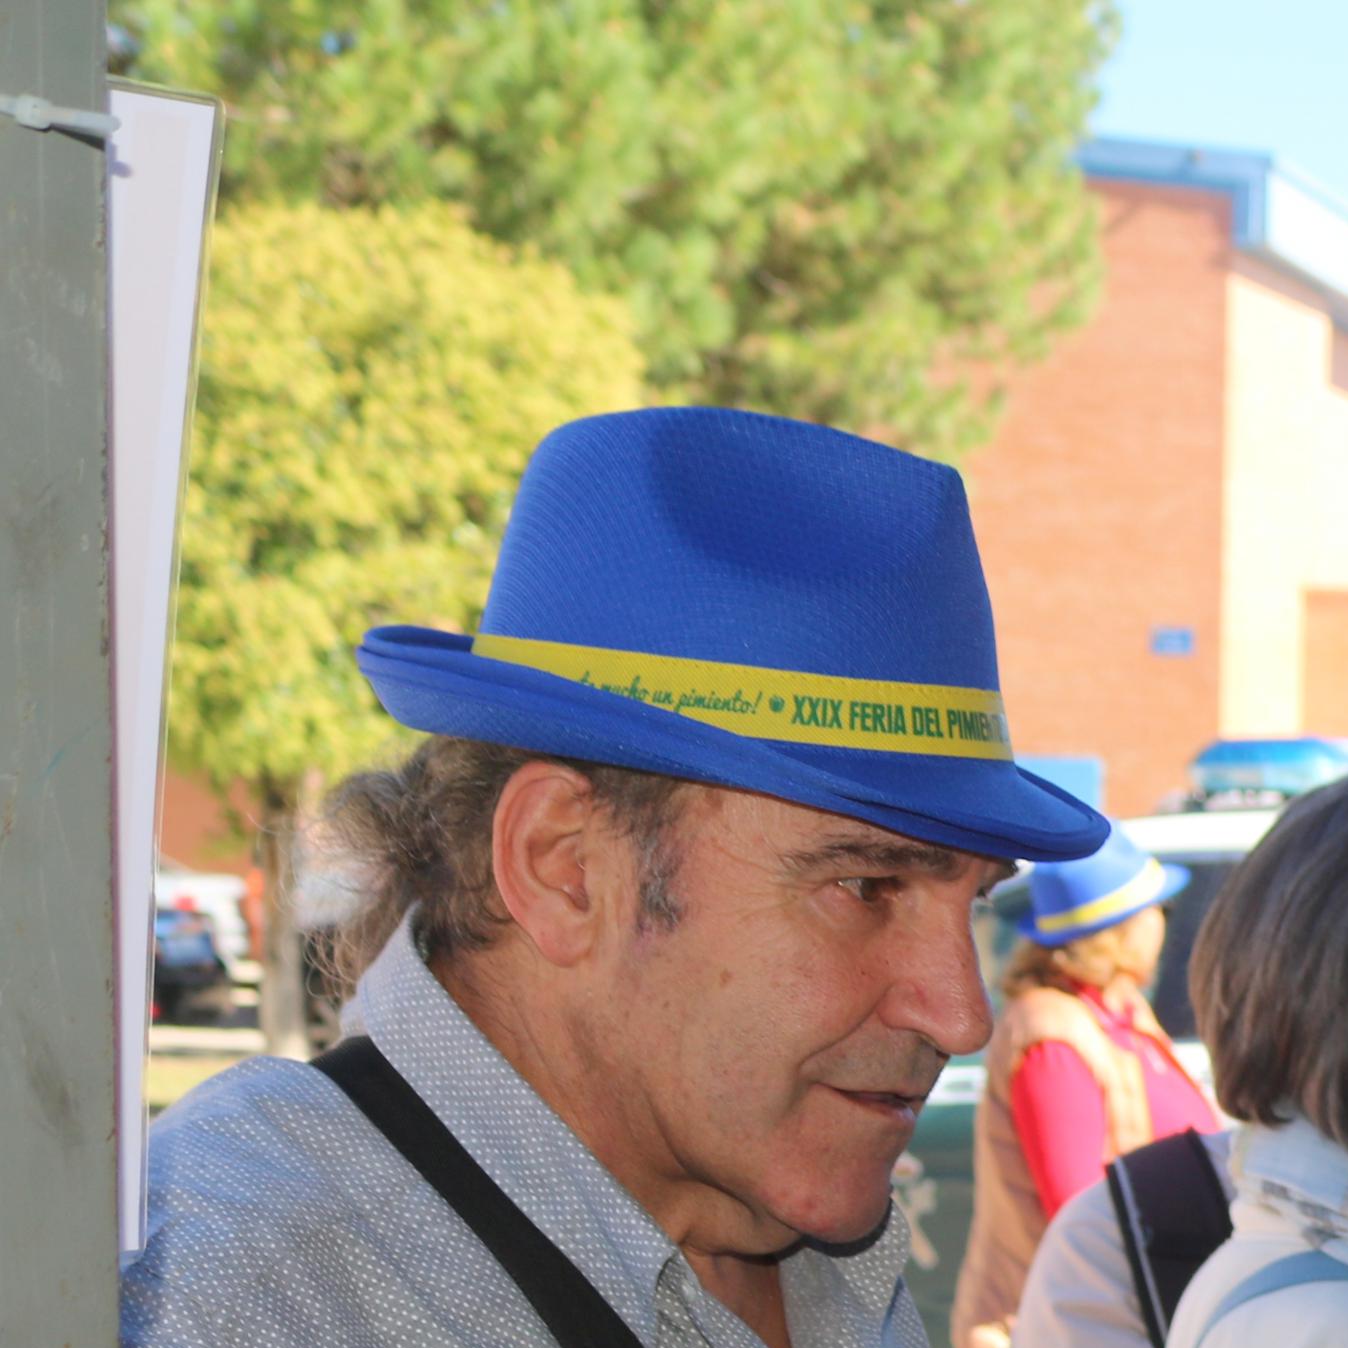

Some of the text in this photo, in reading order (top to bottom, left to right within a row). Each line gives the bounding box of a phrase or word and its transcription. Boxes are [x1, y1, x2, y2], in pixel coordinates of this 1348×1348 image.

[674, 687, 763, 714] pimiento!
[791, 694, 843, 729] XXIX
[849, 701, 907, 736] FERIA
[911, 706, 944, 738] DEL
